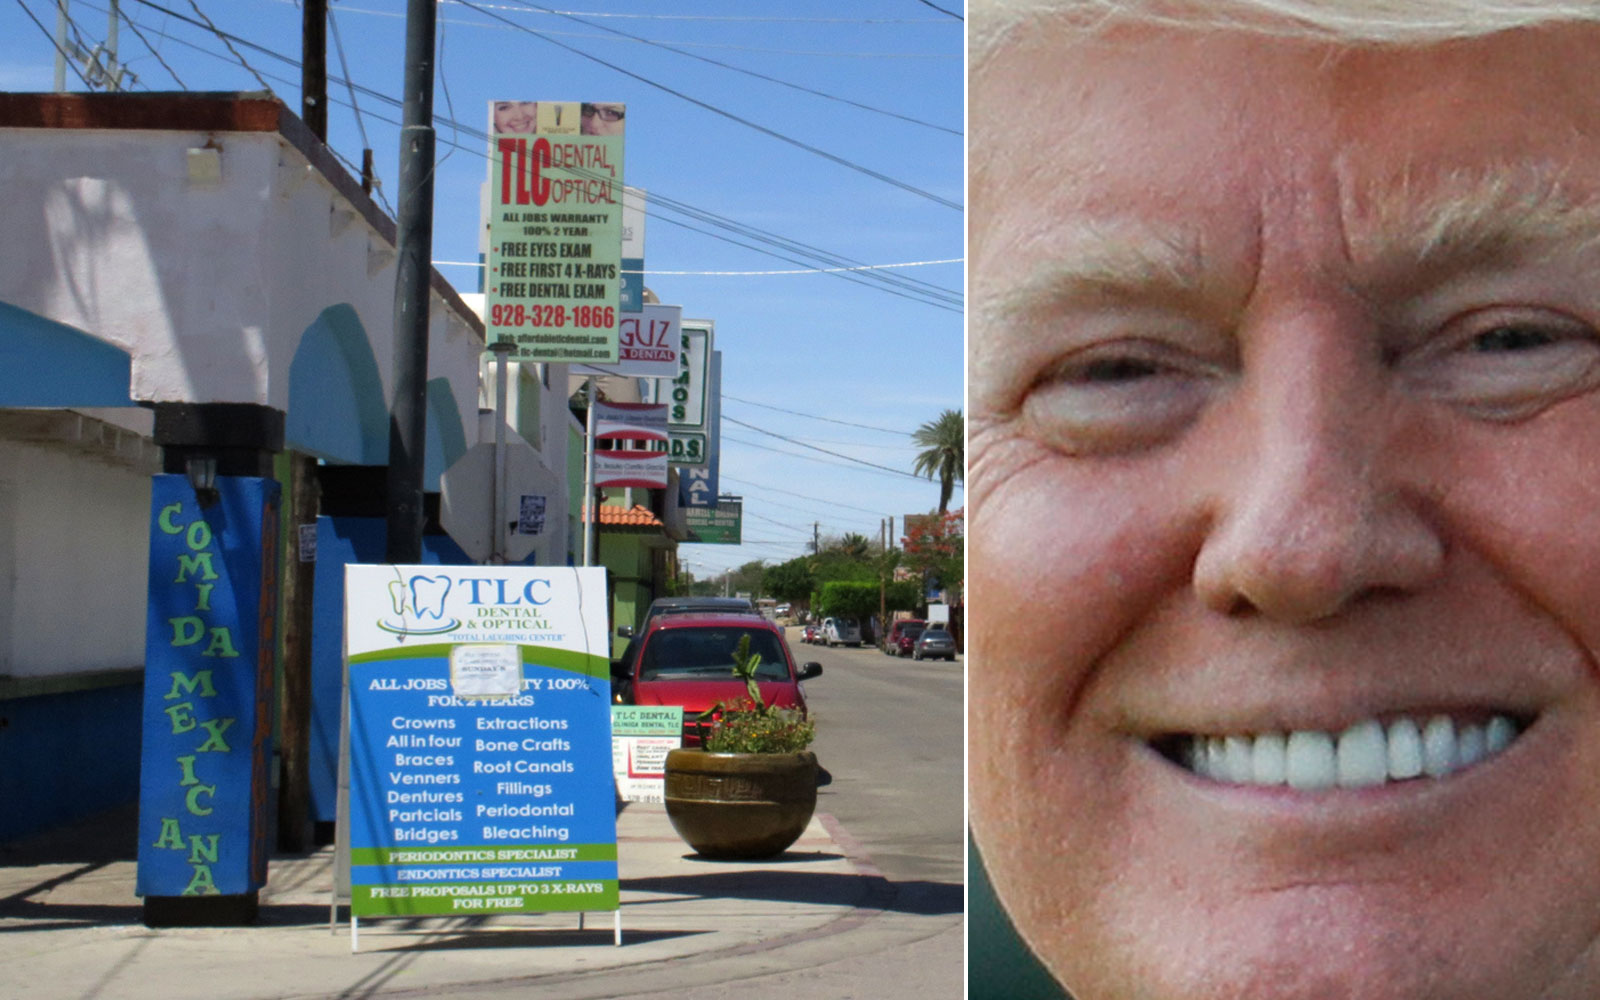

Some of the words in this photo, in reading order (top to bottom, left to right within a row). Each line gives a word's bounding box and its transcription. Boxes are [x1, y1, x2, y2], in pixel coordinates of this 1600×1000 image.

[498, 138, 550, 206] TLC
[552, 143, 611, 169] DENTAL
[552, 178, 616, 205] OPTICAL
[503, 213, 520, 223] ALL
[522, 213, 548, 223] JOBS
[550, 213, 609, 224] WARRANTY
[523, 226, 552, 236] 100%
[554, 227, 560, 236] 2
[562, 227, 589, 237] YEAR
[501, 242, 528, 257] FREE
[530, 243, 557, 258] EYES
[560, 243, 592, 258] EXAM
[501, 262, 528, 277] FREE
[530, 263, 562, 278] FIRST
[564, 264, 573, 278] 4
[575, 264, 616, 280] X-RAYS
[500, 282, 527, 298] FREE
[529, 283, 571, 299] DENTAL
[574, 284, 605, 299] EXAM
[491, 304, 614, 329] 928-328-1866
[629, 350, 674, 360] DENTAL
[458, 579, 552, 605] TLC
[477, 607, 542, 618] DENTAL
[467, 620, 477, 629] &
[482, 619, 552, 629] OPTICAL
[482, 633, 527, 641] LAUGHING
[369, 679, 402, 690] ALL
[403, 679, 448, 690] JOBS
[546, 679, 590, 690] 100%
[428, 695, 463, 707] FOR
[480, 696, 535, 707] YEARS
[392, 716, 456, 729] Crowns
[616, 711, 636, 719] TLC
[640, 711, 677, 720] DENTAL
[477, 716, 568, 730] Extractions
[386, 735, 408, 748] All
[411, 735, 426, 747] in
[428, 735, 462, 748] four
[476, 738, 519, 751] Bone
[521, 738, 570, 751] Crafts
[395, 753, 454, 766] Braces
[474, 761, 512, 773] Root
[514, 760, 574, 773] Canals
[389, 771, 460, 785] Venners
[387, 790, 464, 803] Dentures
[497, 782, 552, 797] Fillings
[389, 808, 462, 822] Partcials
[477, 803, 574, 817] Periodontal
[395, 827, 458, 843] Bridges
[483, 825, 569, 840] Bleaching
[389, 850, 495, 863] PERIODONTICS
[497, 848, 578, 860] SPECIALIST
[397, 868, 480, 880] ENDONTICS
[481, 866, 562, 878] SPECIALIST
[370, 887, 409, 898] FREE
[411, 885, 496, 897] PROPOSALS
[497, 884, 516, 895] UP
[517, 884, 539, 895] TO
[541, 883, 550, 894] 3
[551, 882, 604, 894] X-RAYS
[453, 898, 483, 909] FOR
[485, 897, 524, 908] FREE
